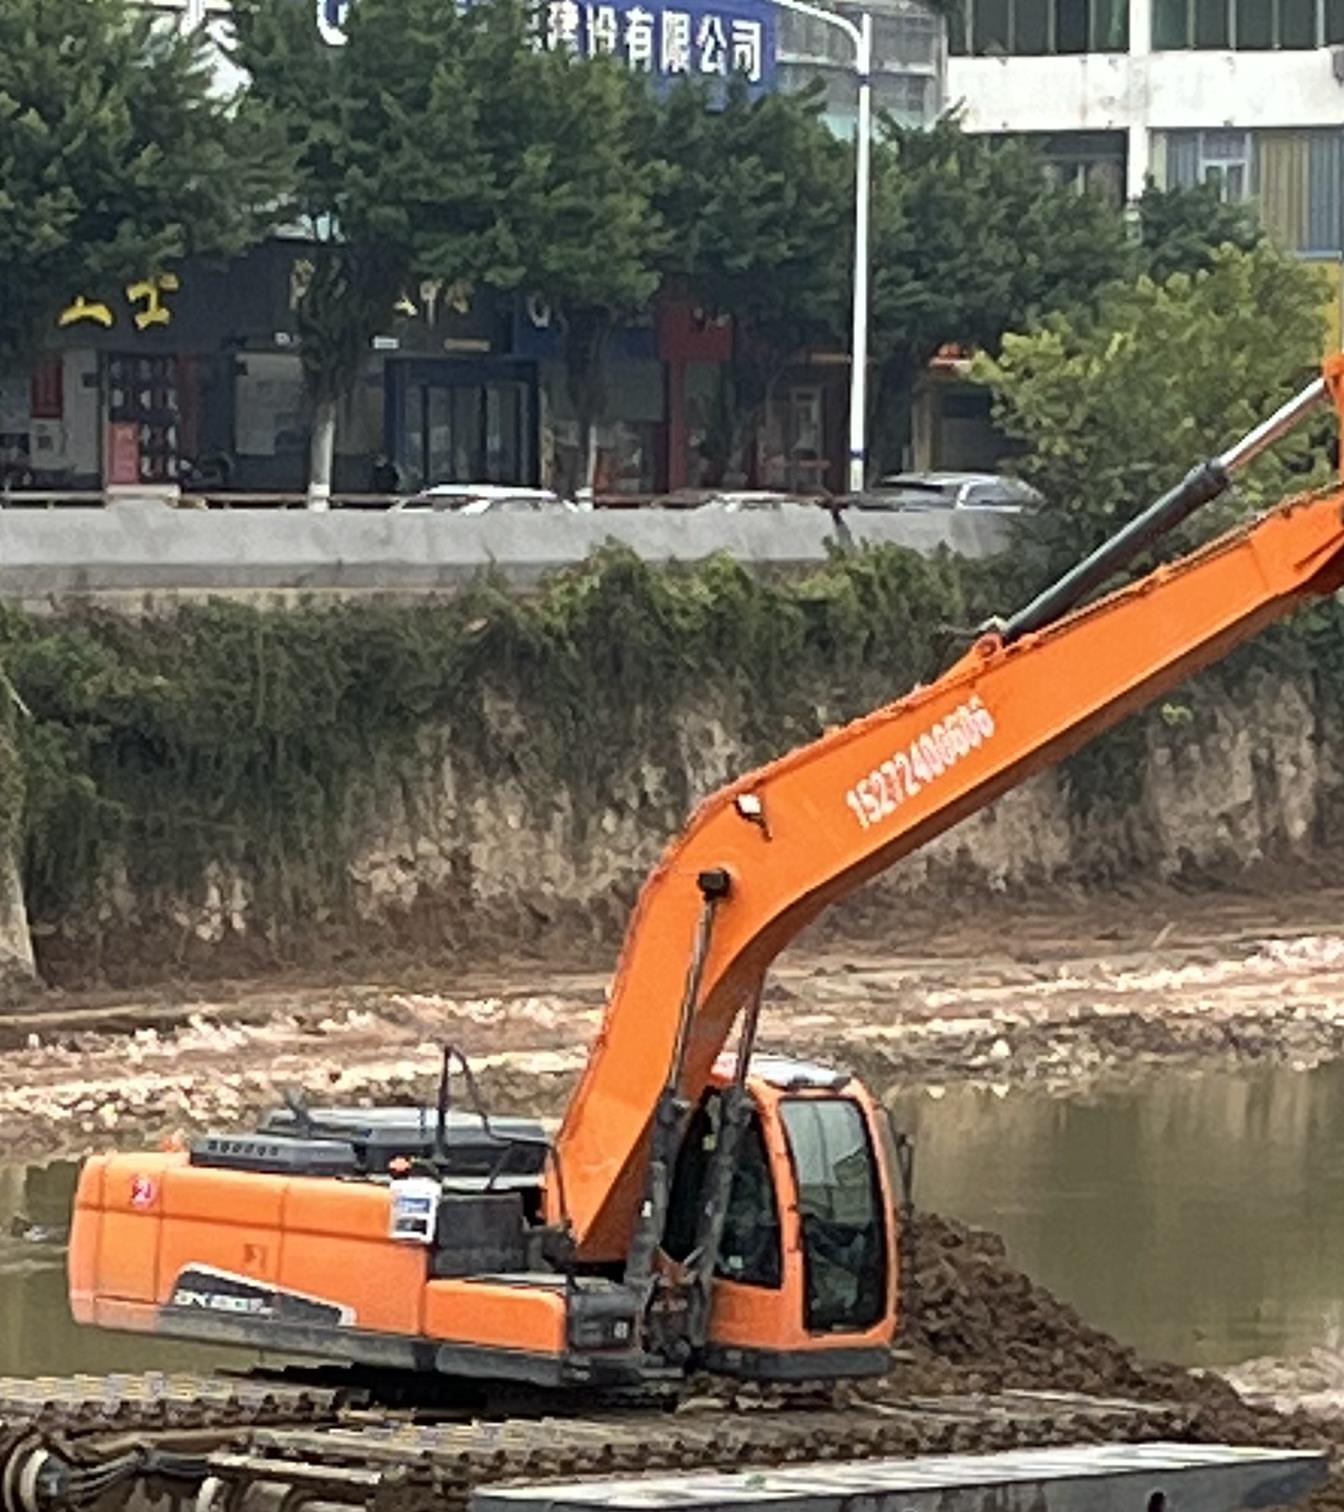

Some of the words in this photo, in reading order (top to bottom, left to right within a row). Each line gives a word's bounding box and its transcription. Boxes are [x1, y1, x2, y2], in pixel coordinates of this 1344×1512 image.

[522, 0, 762, 82] 建设有限公司
